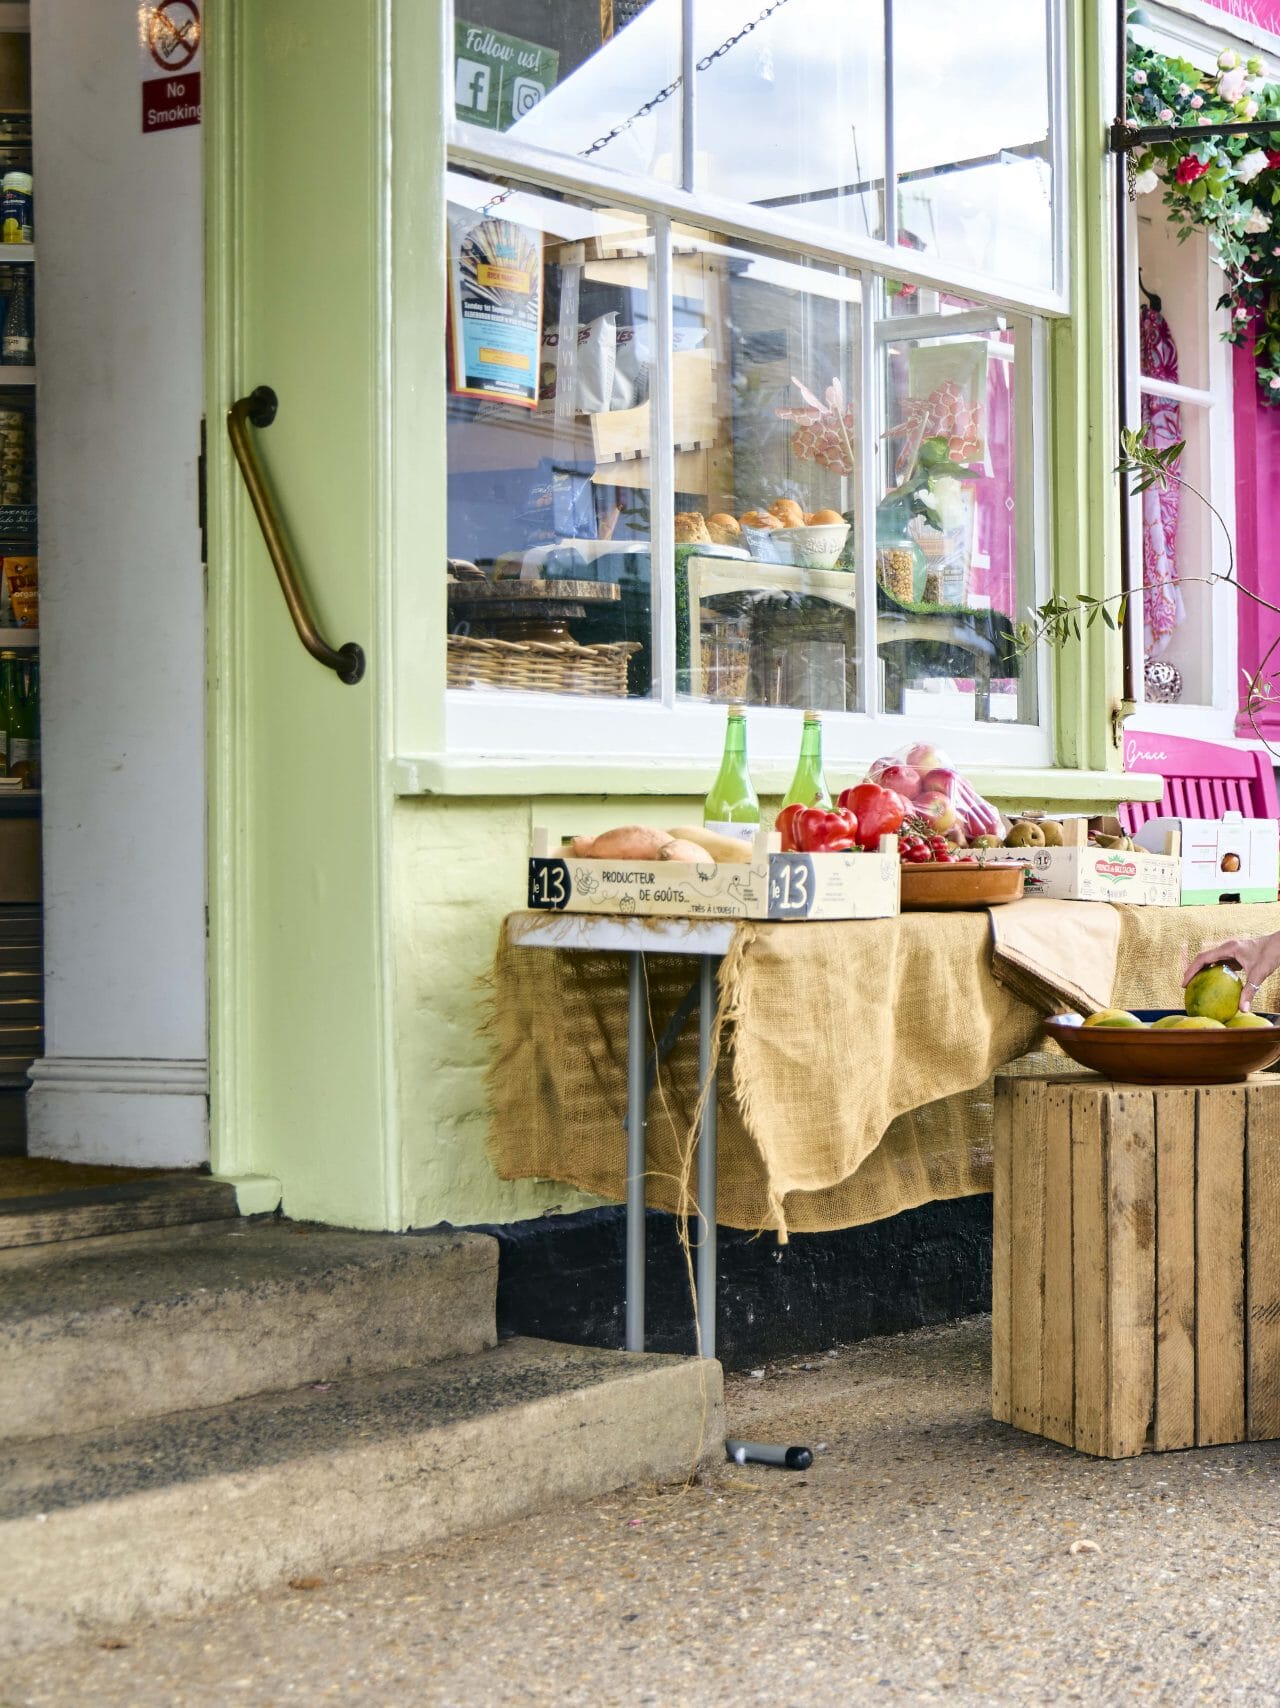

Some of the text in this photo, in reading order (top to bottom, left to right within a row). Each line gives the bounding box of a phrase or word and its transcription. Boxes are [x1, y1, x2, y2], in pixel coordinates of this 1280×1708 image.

[466, 28, 541, 72] Follow us!
[167, 82, 186, 98] No
[1126, 739, 1168, 769] Grace
[538, 866, 566, 903] 13
[602, 870, 656, 885] PRODUCTEUR
[771, 879, 780, 899] le
[780, 864, 808, 909] 13
[639, 890, 650, 901] DE
